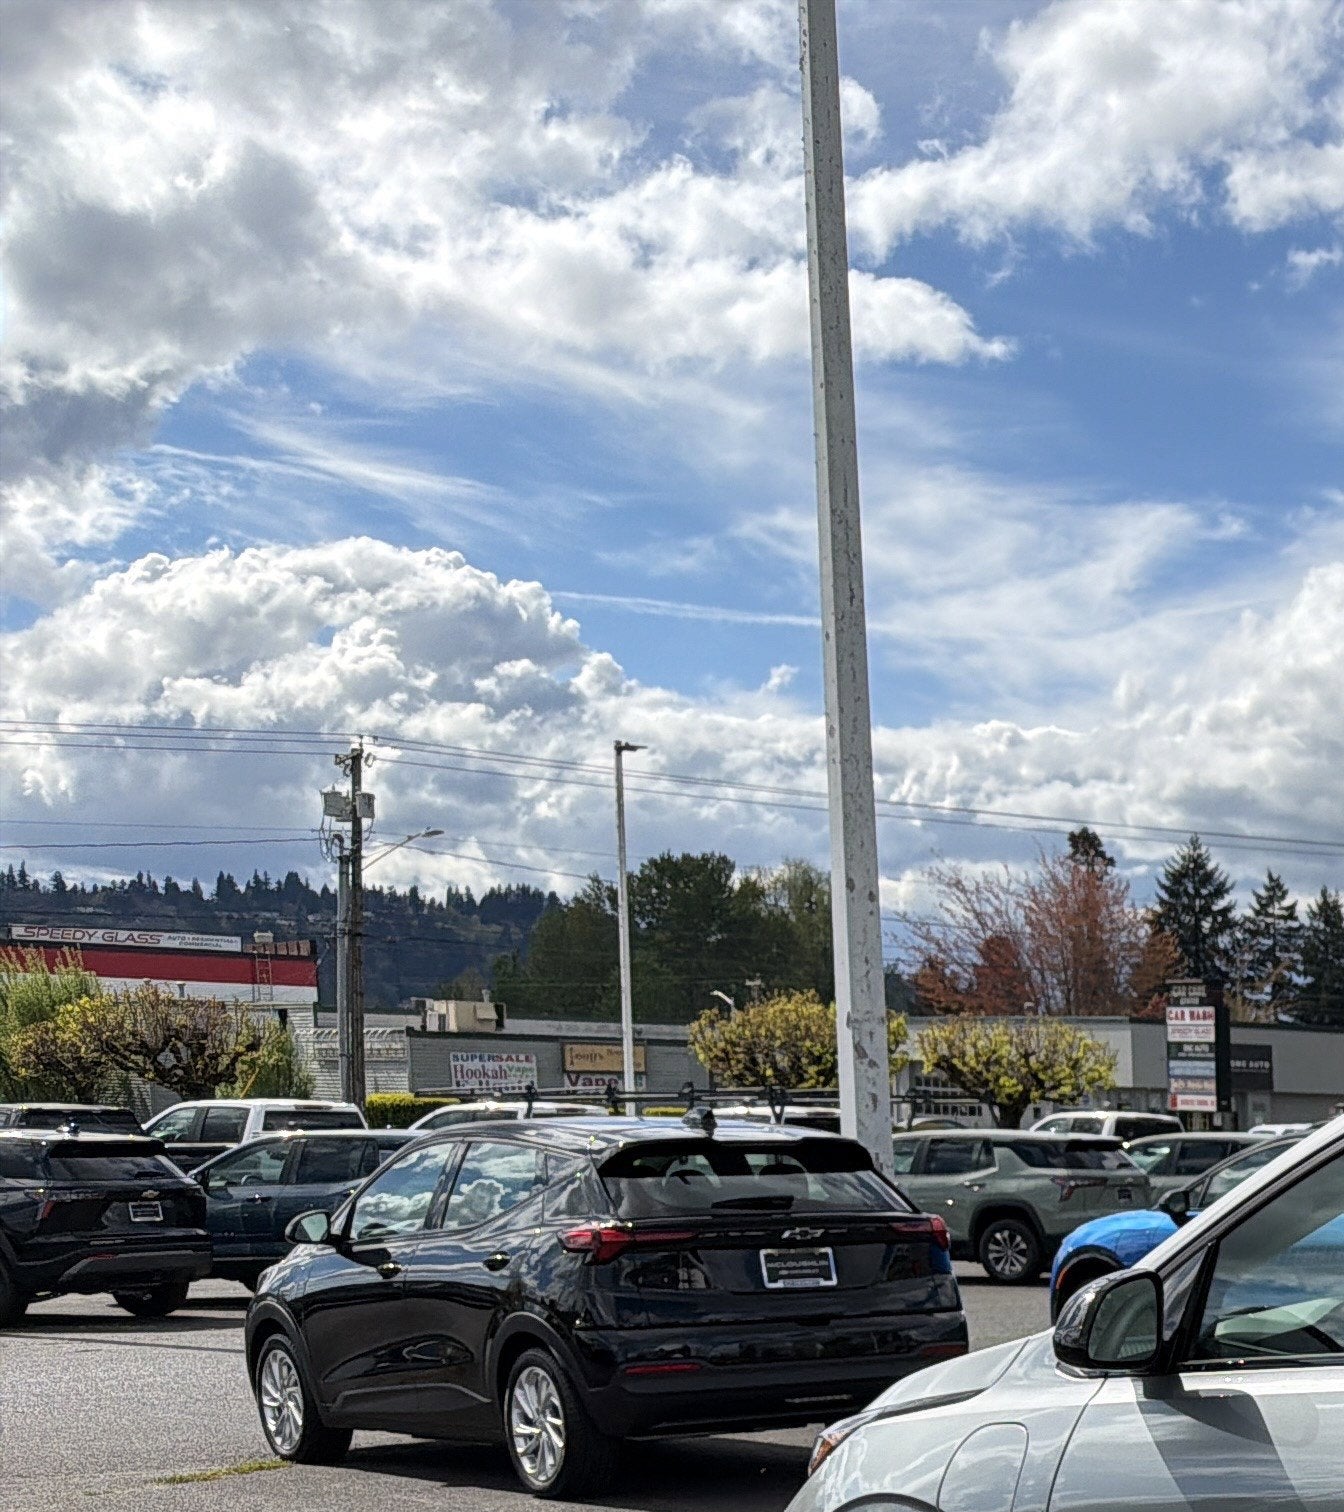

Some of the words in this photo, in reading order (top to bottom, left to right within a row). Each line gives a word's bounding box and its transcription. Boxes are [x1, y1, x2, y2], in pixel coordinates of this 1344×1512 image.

[16, 926, 98, 942] SPEEDY
[102, 930, 164, 945] GLASS
[1168, 1009, 1186, 1021] CAR
[453, 1063, 508, 1080] Hookah
